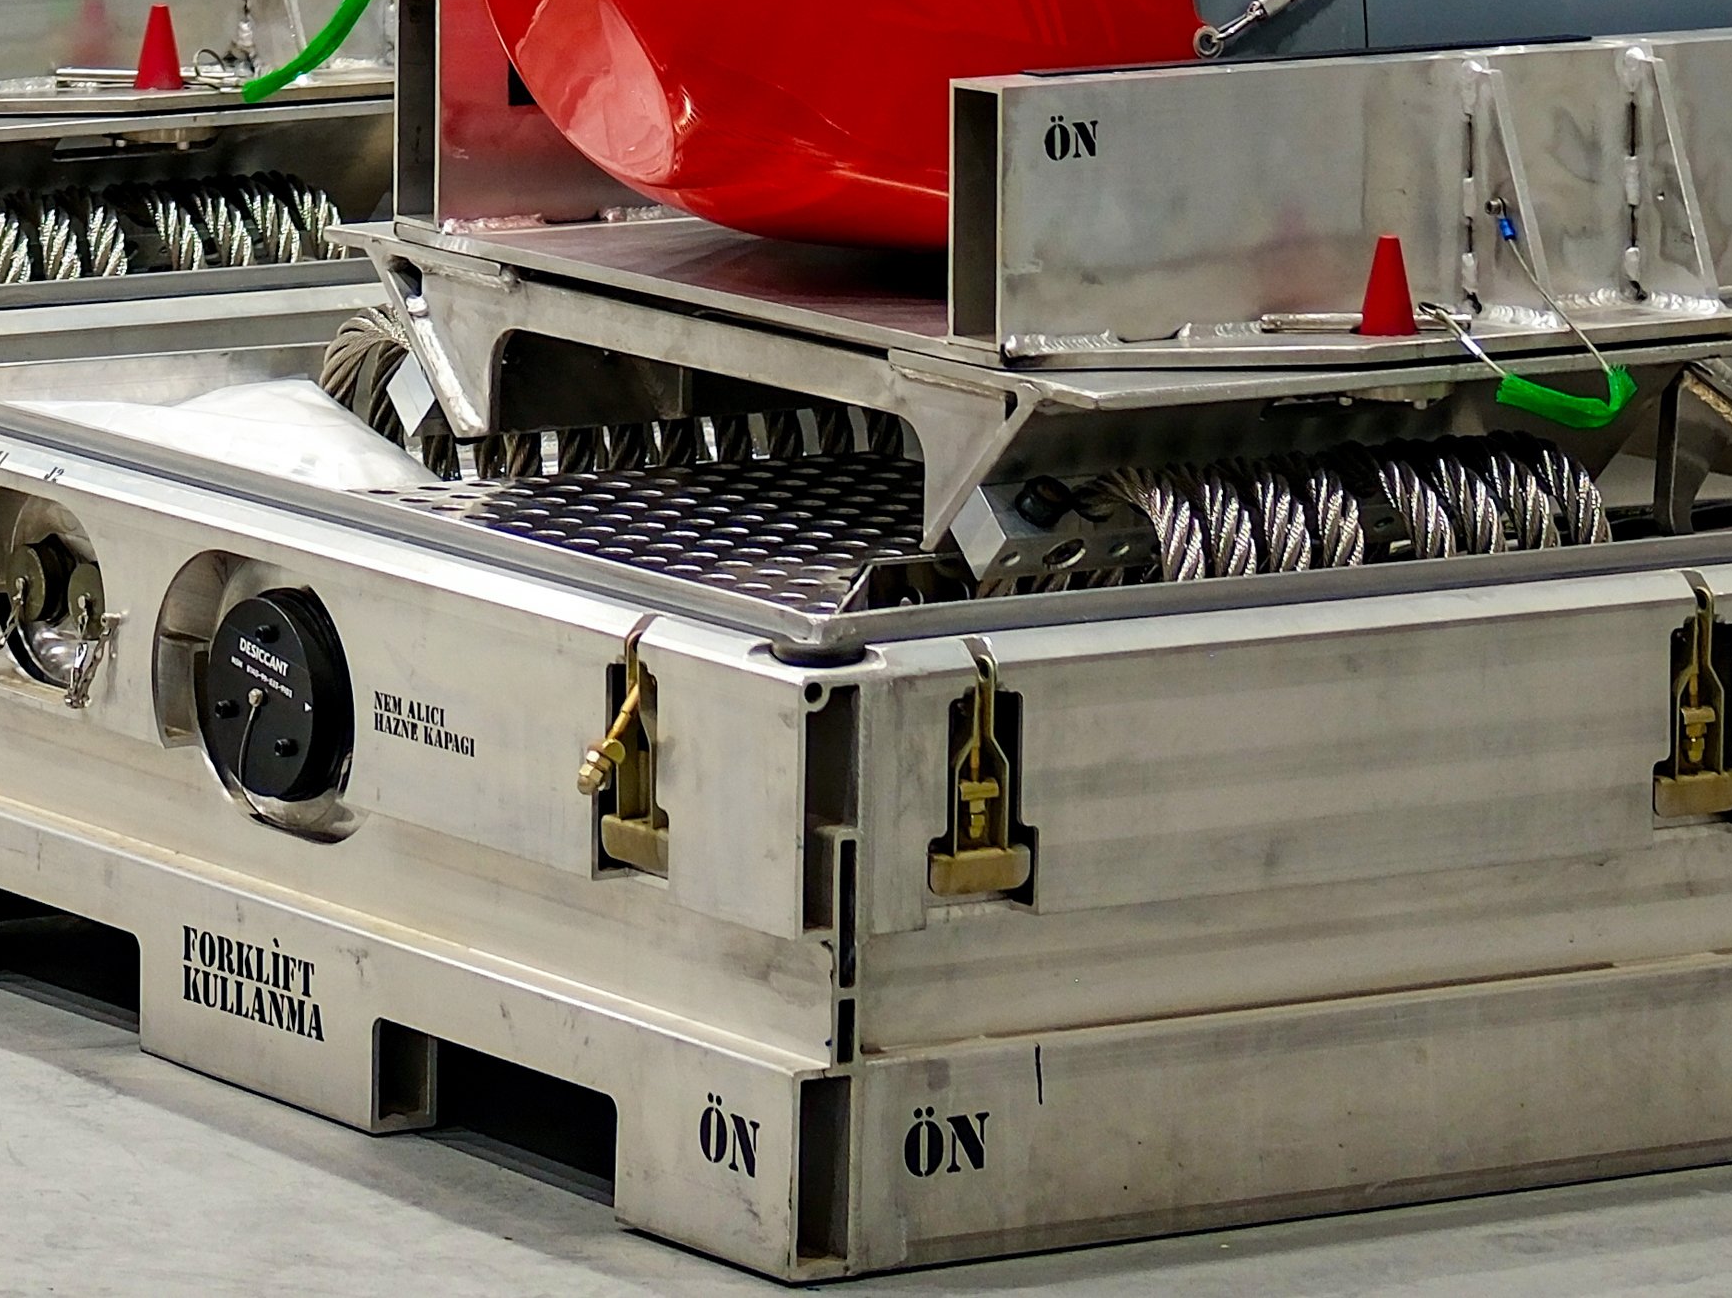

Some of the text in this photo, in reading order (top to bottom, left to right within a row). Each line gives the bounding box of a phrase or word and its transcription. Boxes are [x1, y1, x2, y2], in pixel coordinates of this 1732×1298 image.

[1044, 114, 1099, 161] ÖN
[44, 466, 64, 483] J2
[239, 637, 289, 676] DESICCANT
[374, 691, 445, 728] NEM ALICI
[374, 712, 418, 741] HAZNE
[183, 925, 315, 999] FORKLİFT
[182, 965, 324, 1042] KULLANMA
[700, 1093, 760, 1178] ÖN
[904, 1106, 990, 1178] ÖN
